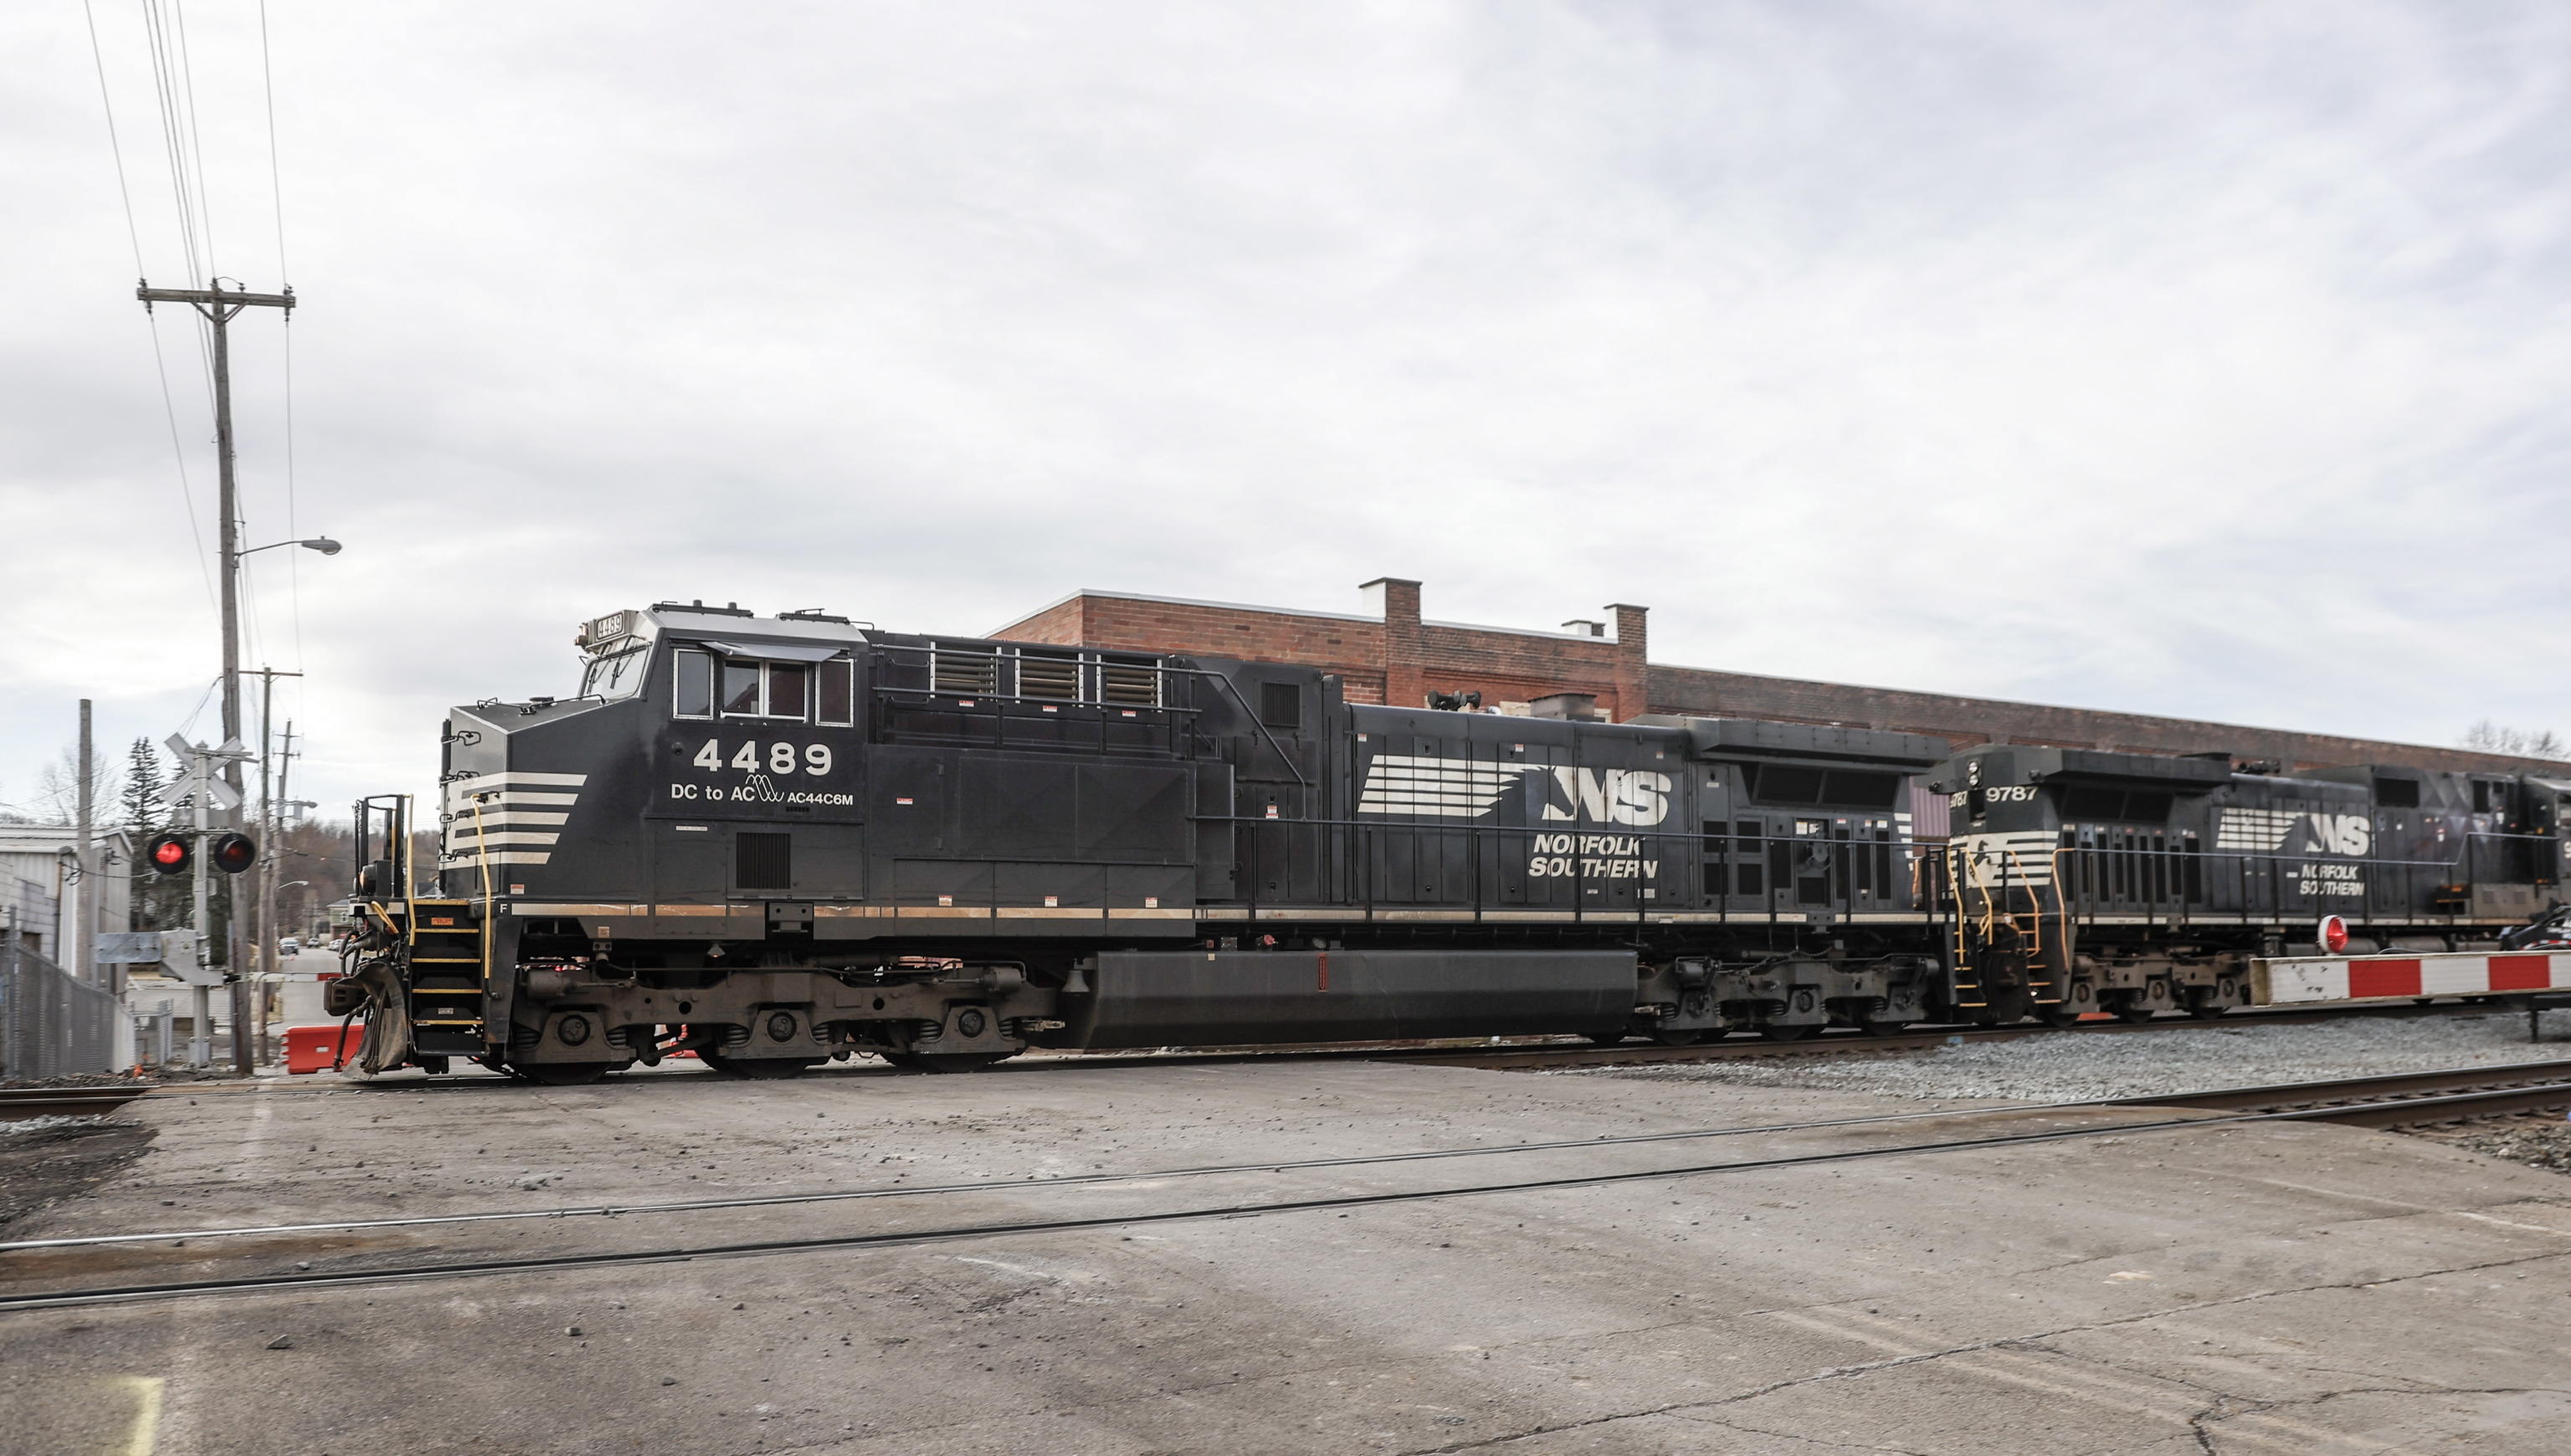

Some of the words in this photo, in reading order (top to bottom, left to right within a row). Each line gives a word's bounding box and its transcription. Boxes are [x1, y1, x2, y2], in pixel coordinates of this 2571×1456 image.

[598, 615, 621, 636] 4489
[694, 738, 832, 776] 4489
[671, 783, 697, 800] DC
[706, 785, 723, 801] to
[731, 786, 755, 802] AC
[787, 792, 854, 806] AC44C6M
[1542, 765, 1672, 826] NS
[1986, 786, 2038, 802] 9787
[2305, 813, 2371, 856] NS
[500, 904, 508, 914] F
